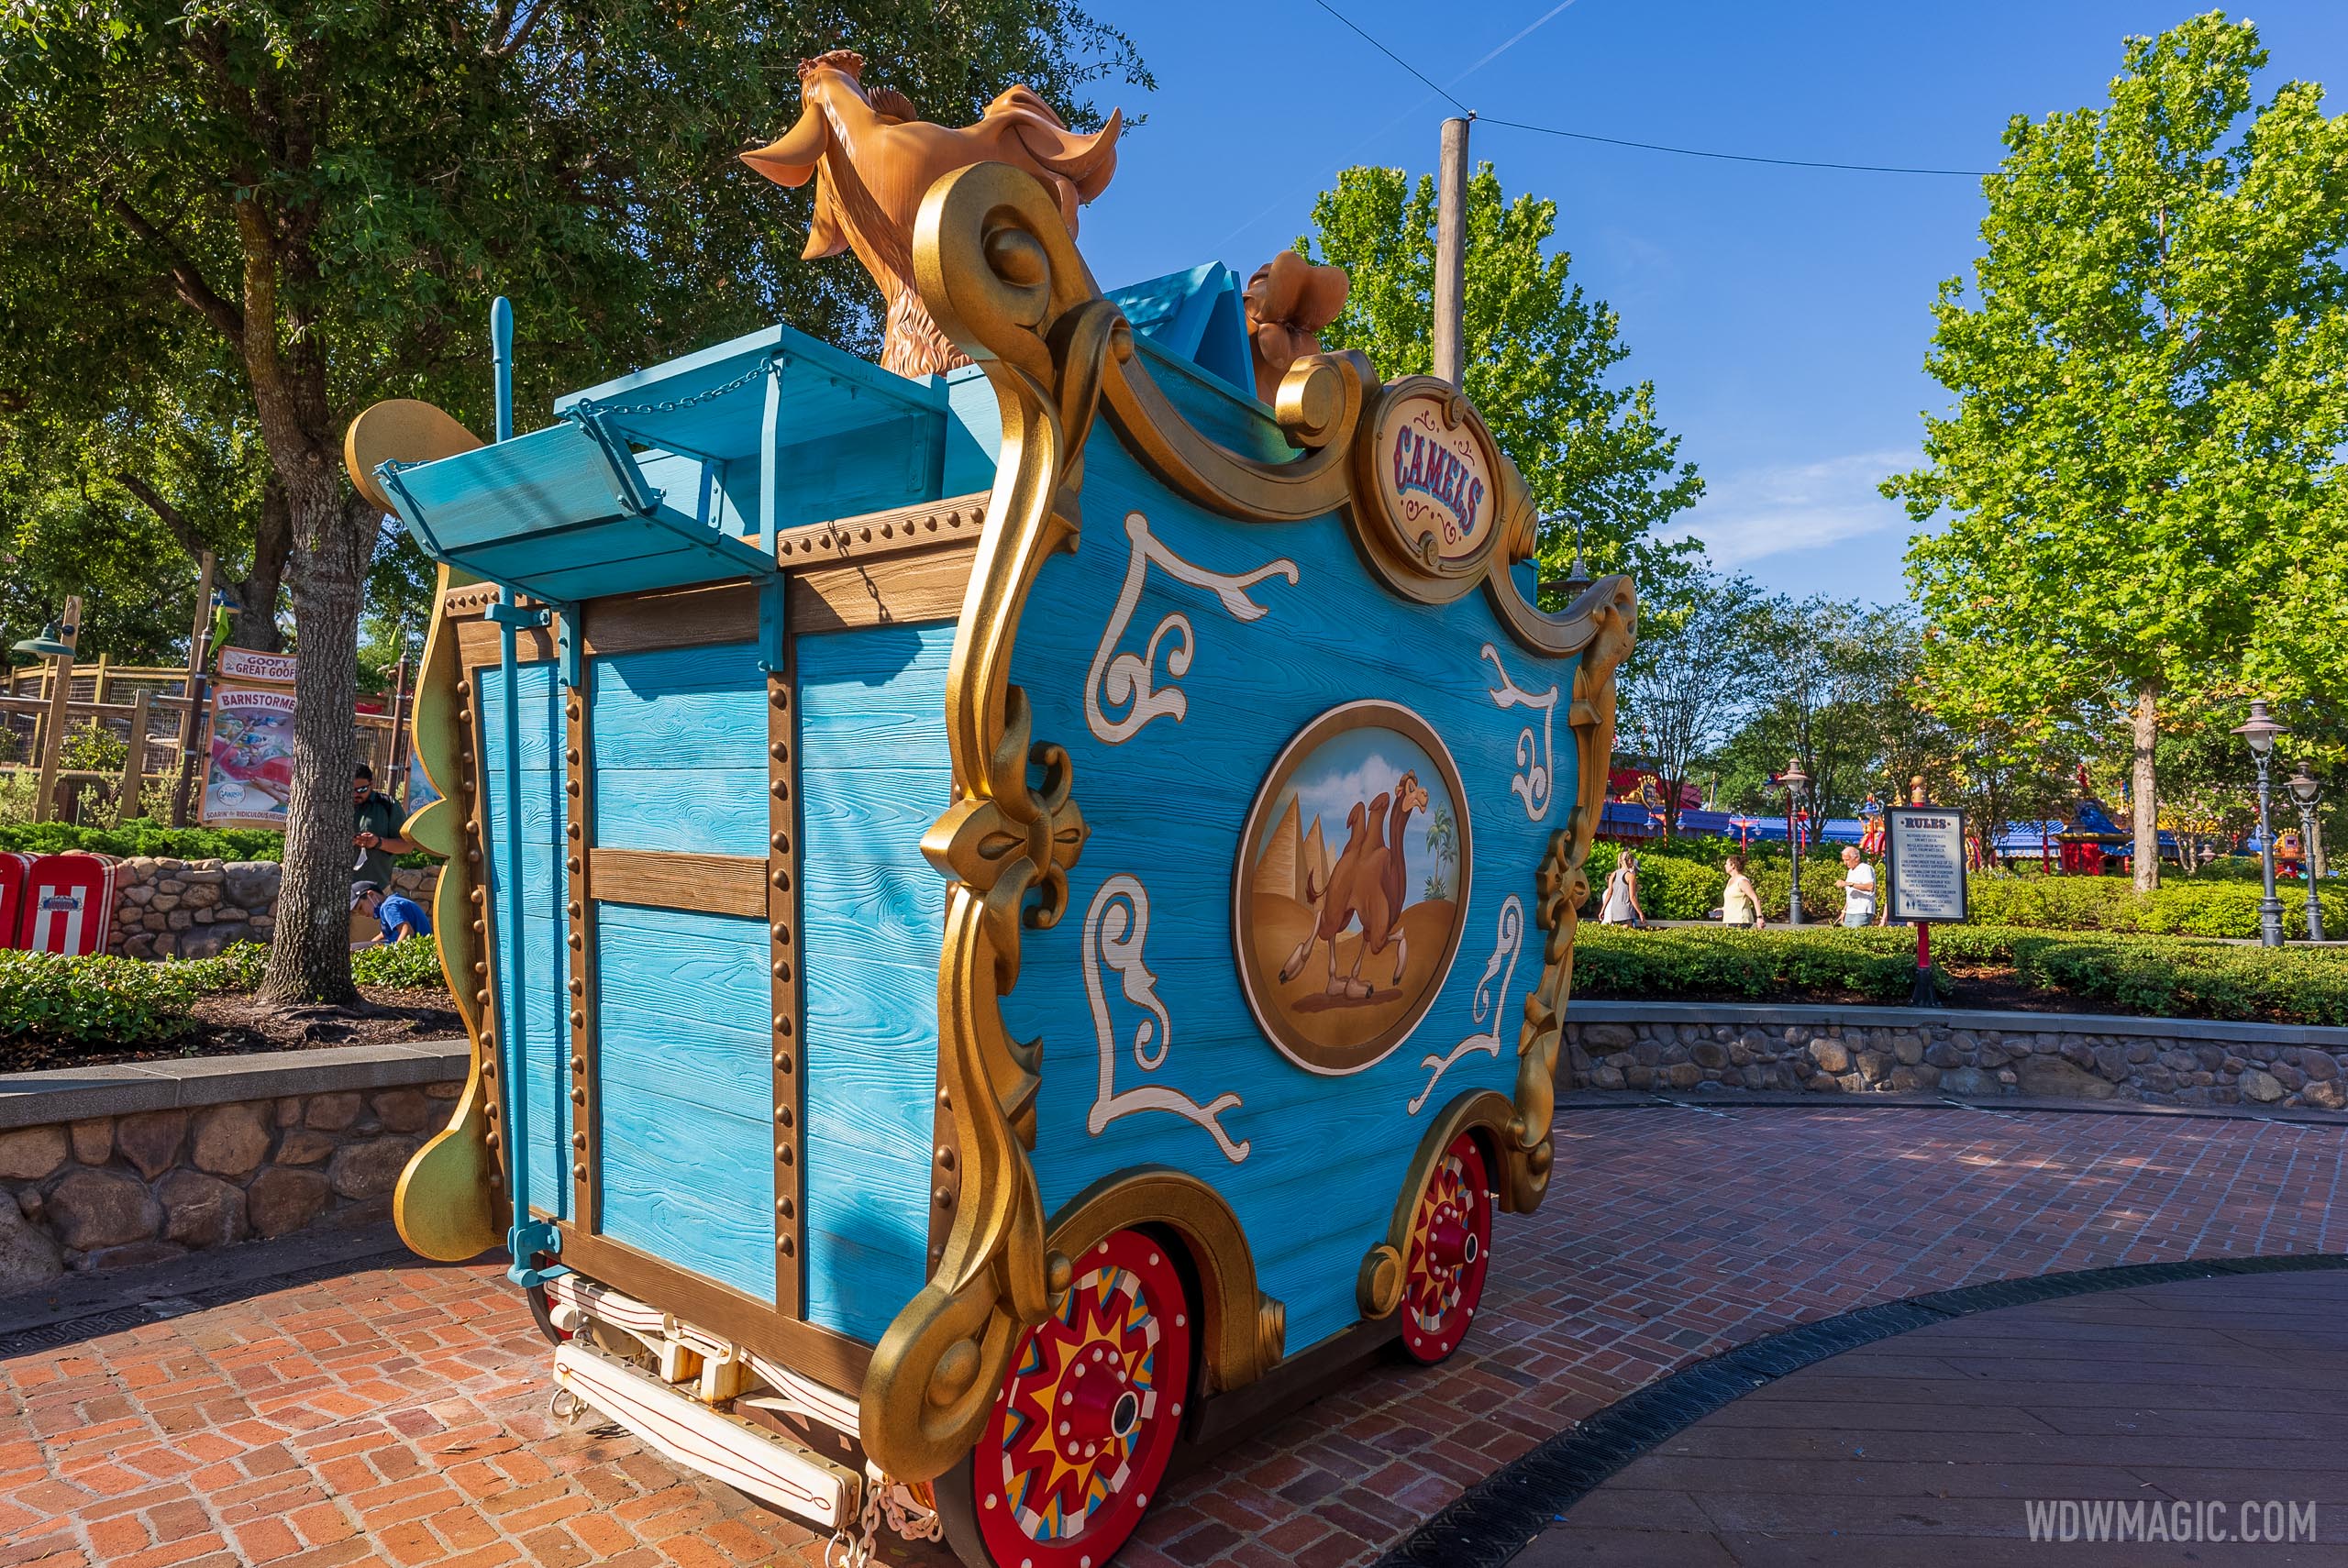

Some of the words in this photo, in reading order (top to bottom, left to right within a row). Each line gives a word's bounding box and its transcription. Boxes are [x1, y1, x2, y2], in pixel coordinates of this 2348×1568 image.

[1393, 425, 1484, 536] CAMELS
[248, 657, 289, 668] GOOFY
[236, 663, 267, 676] GREAT
[1904, 817, 1946, 829] RULES
